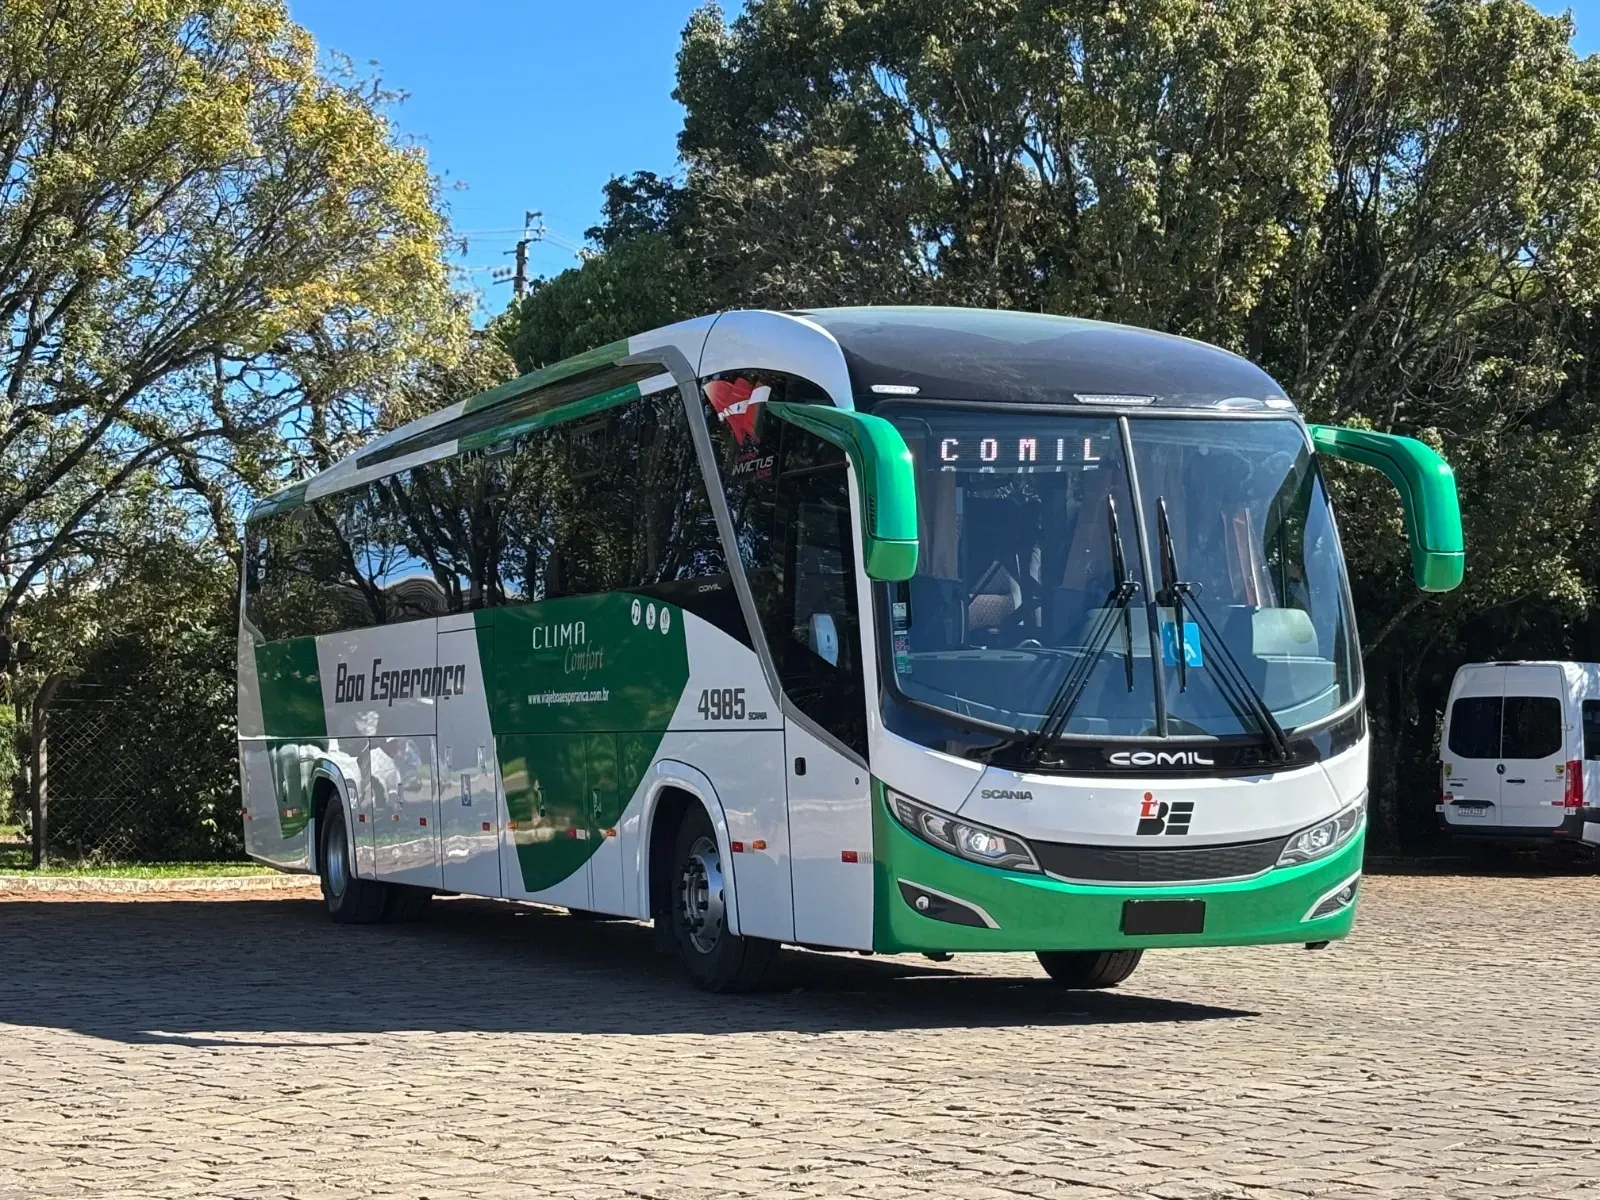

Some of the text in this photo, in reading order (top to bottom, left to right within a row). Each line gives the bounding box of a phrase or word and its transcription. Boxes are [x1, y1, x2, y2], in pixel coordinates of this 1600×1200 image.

[941, 438, 1100, 461] COMIL
[731, 455, 774, 476] INVICTUS
[698, 583, 722, 593] COMIL
[532, 621, 585, 650] CLIMA
[564, 640, 604, 680] Comfort
[335, 658, 466, 707] Boa Esperança
[528, 687, 609, 707] www.viajeboaesperanca.com.br
[697, 688, 746, 721] 4985
[748, 712, 768, 721] SCANIA
[1109, 751, 1214, 766] COMIL
[981, 789, 1033, 800] SCANIA
